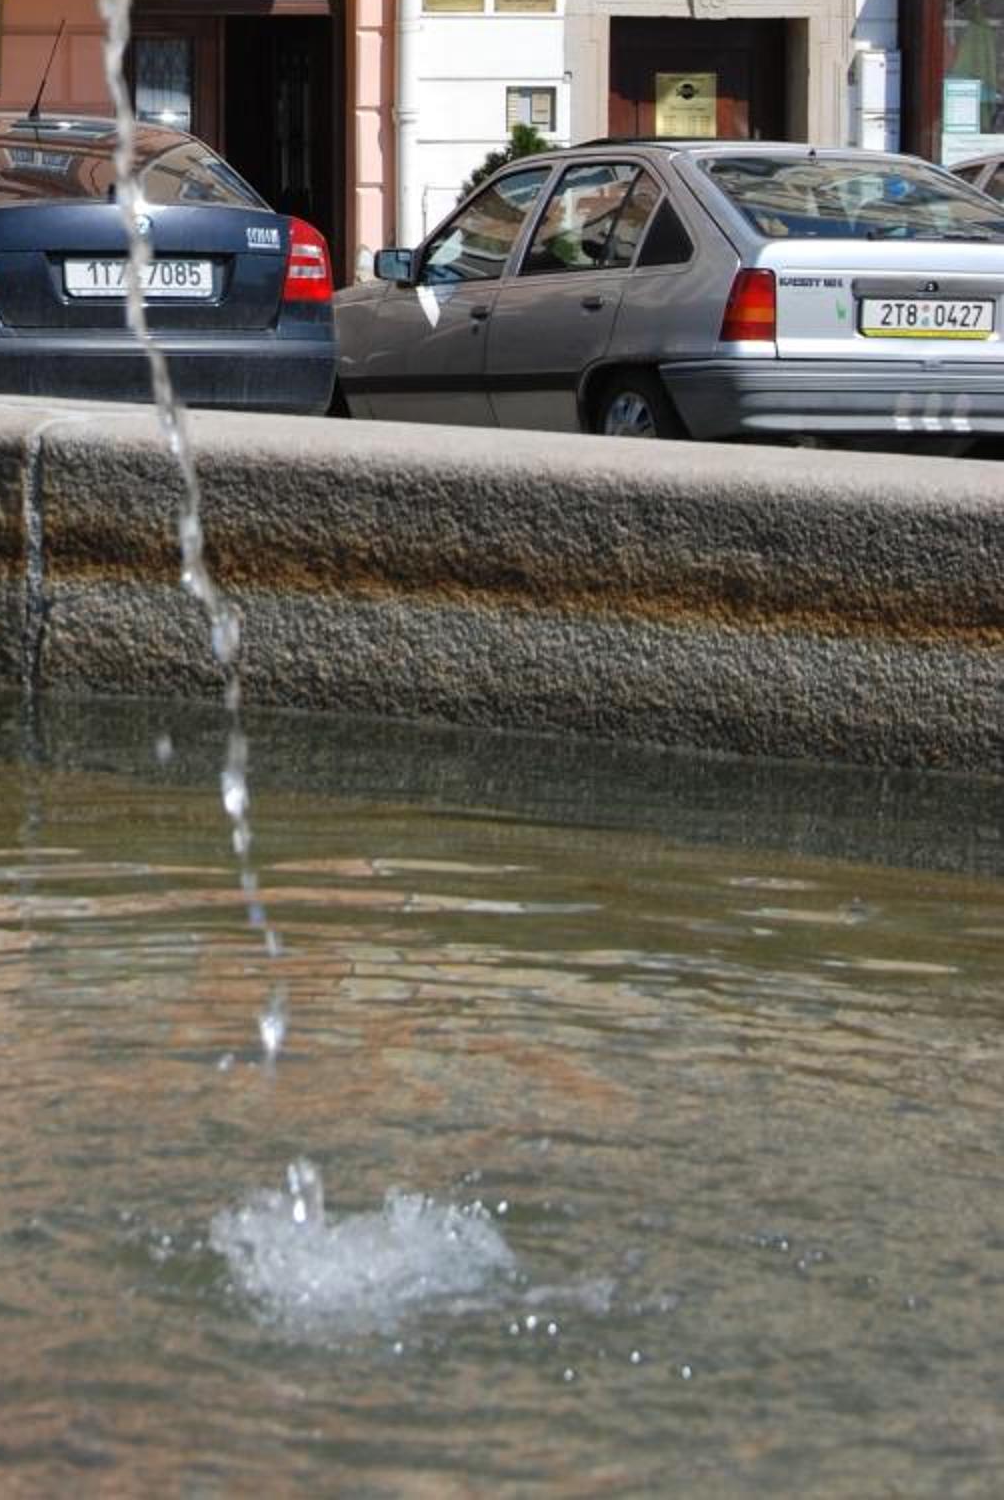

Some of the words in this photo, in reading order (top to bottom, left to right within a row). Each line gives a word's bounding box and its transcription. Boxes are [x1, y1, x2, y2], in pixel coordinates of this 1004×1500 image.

[147, 261, 202, 286] 7085
[880, 303, 917, 327] 2T8
[935, 304, 984, 328] 0427
